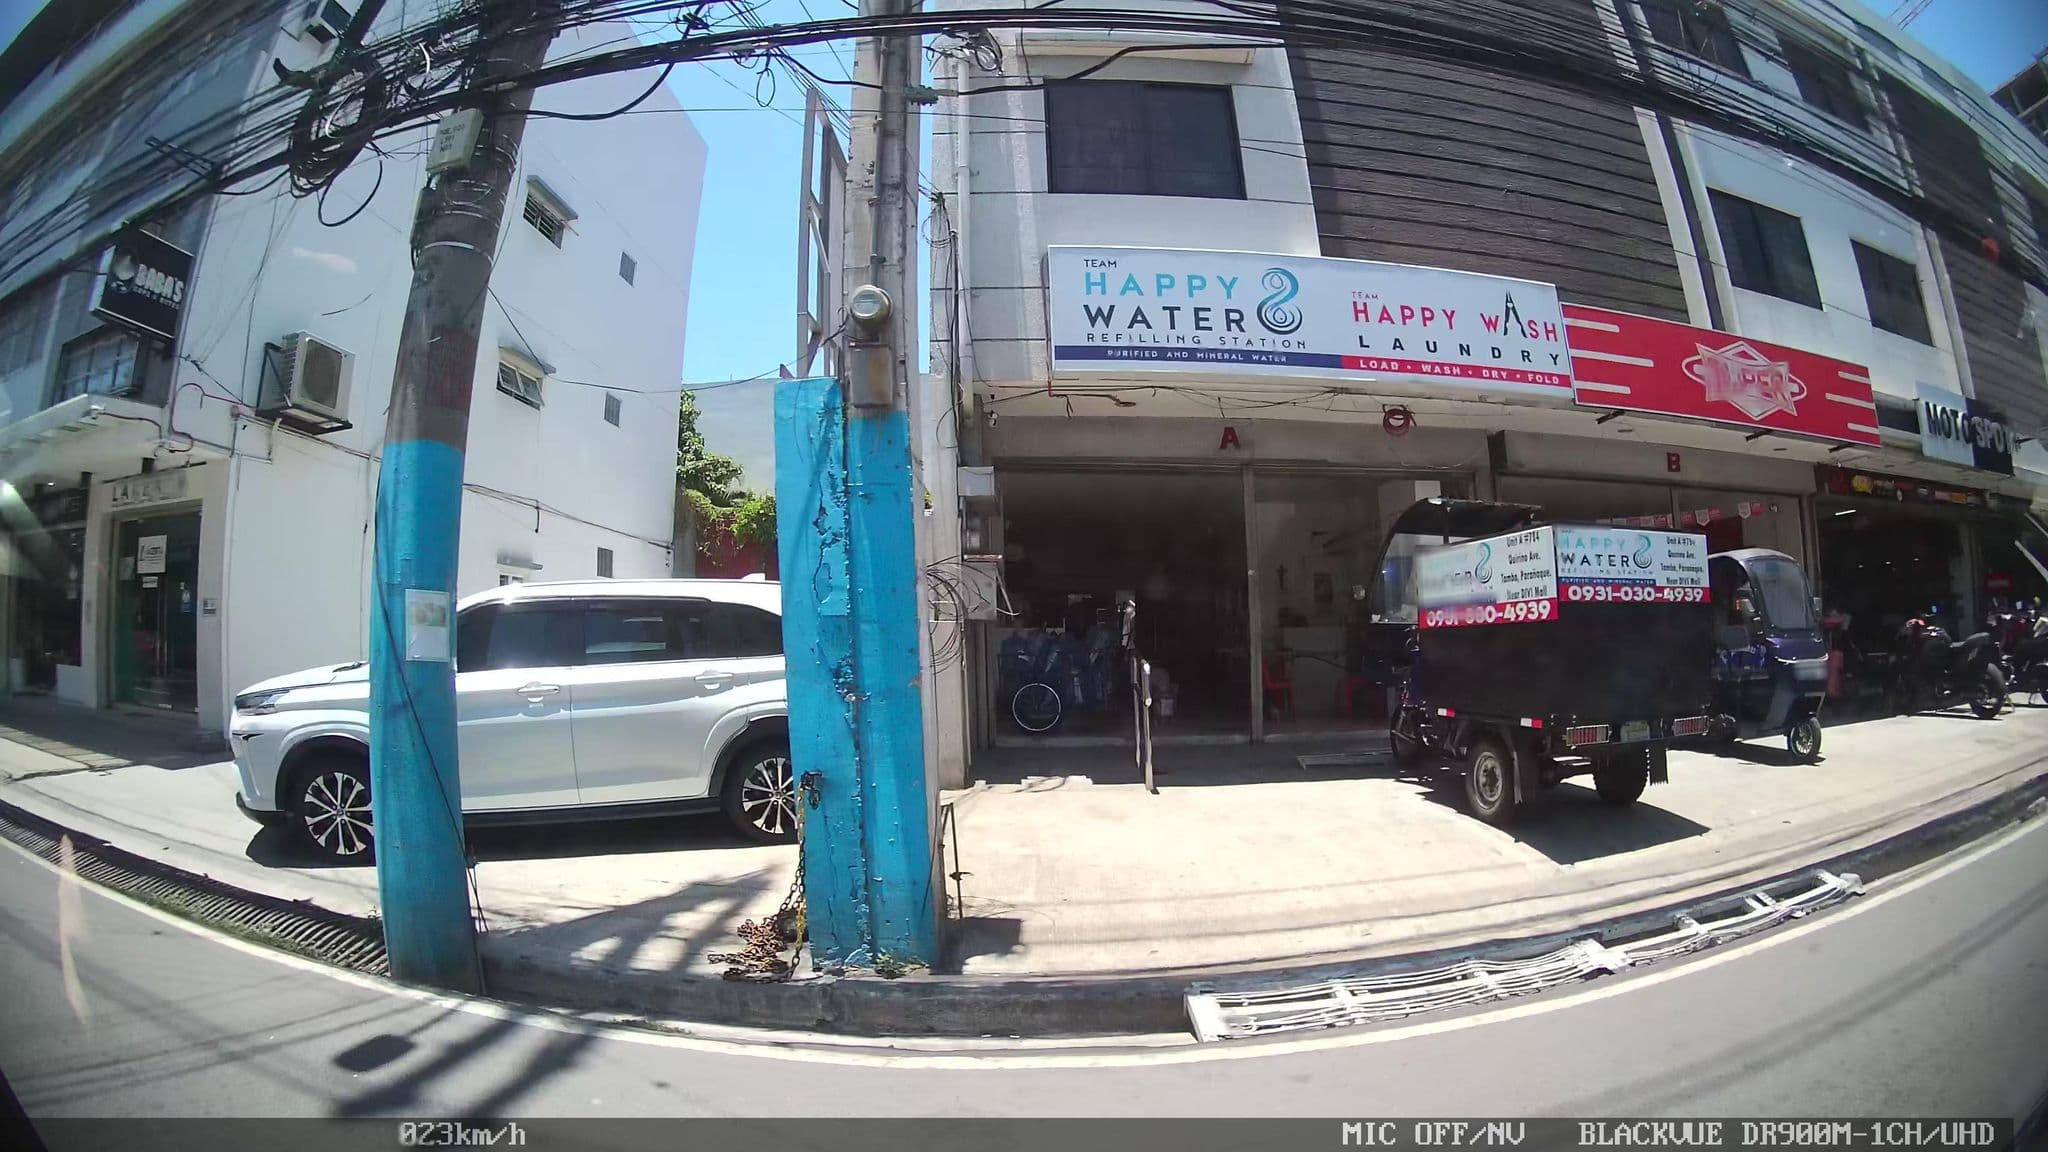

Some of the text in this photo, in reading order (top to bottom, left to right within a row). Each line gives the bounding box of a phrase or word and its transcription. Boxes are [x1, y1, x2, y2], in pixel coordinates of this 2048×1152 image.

[1083, 259, 1117, 268] TEAM
[1084, 271, 1239, 300] HAPPY
[1351, 291, 1379, 300] TEAM
[1083, 304, 1246, 333] WATER
[1352, 290, 1558, 343] HAPPY WASH
[1087, 332, 1306, 349] REFILLING STATION
[1358, 335, 1559, 366] LAUNDRY
[1107, 349, 1287, 363] PURIFIED AND MINERAL WATER
[1360, 359, 1560, 385] LOAD WASH DRY FOLD
[1219, 426, 1241, 450] A
[1666, 452, 1681, 473] B
[1560, 552, 1630, 568] WATER
[1567, 585, 1704, 602] 0931-030-4939
